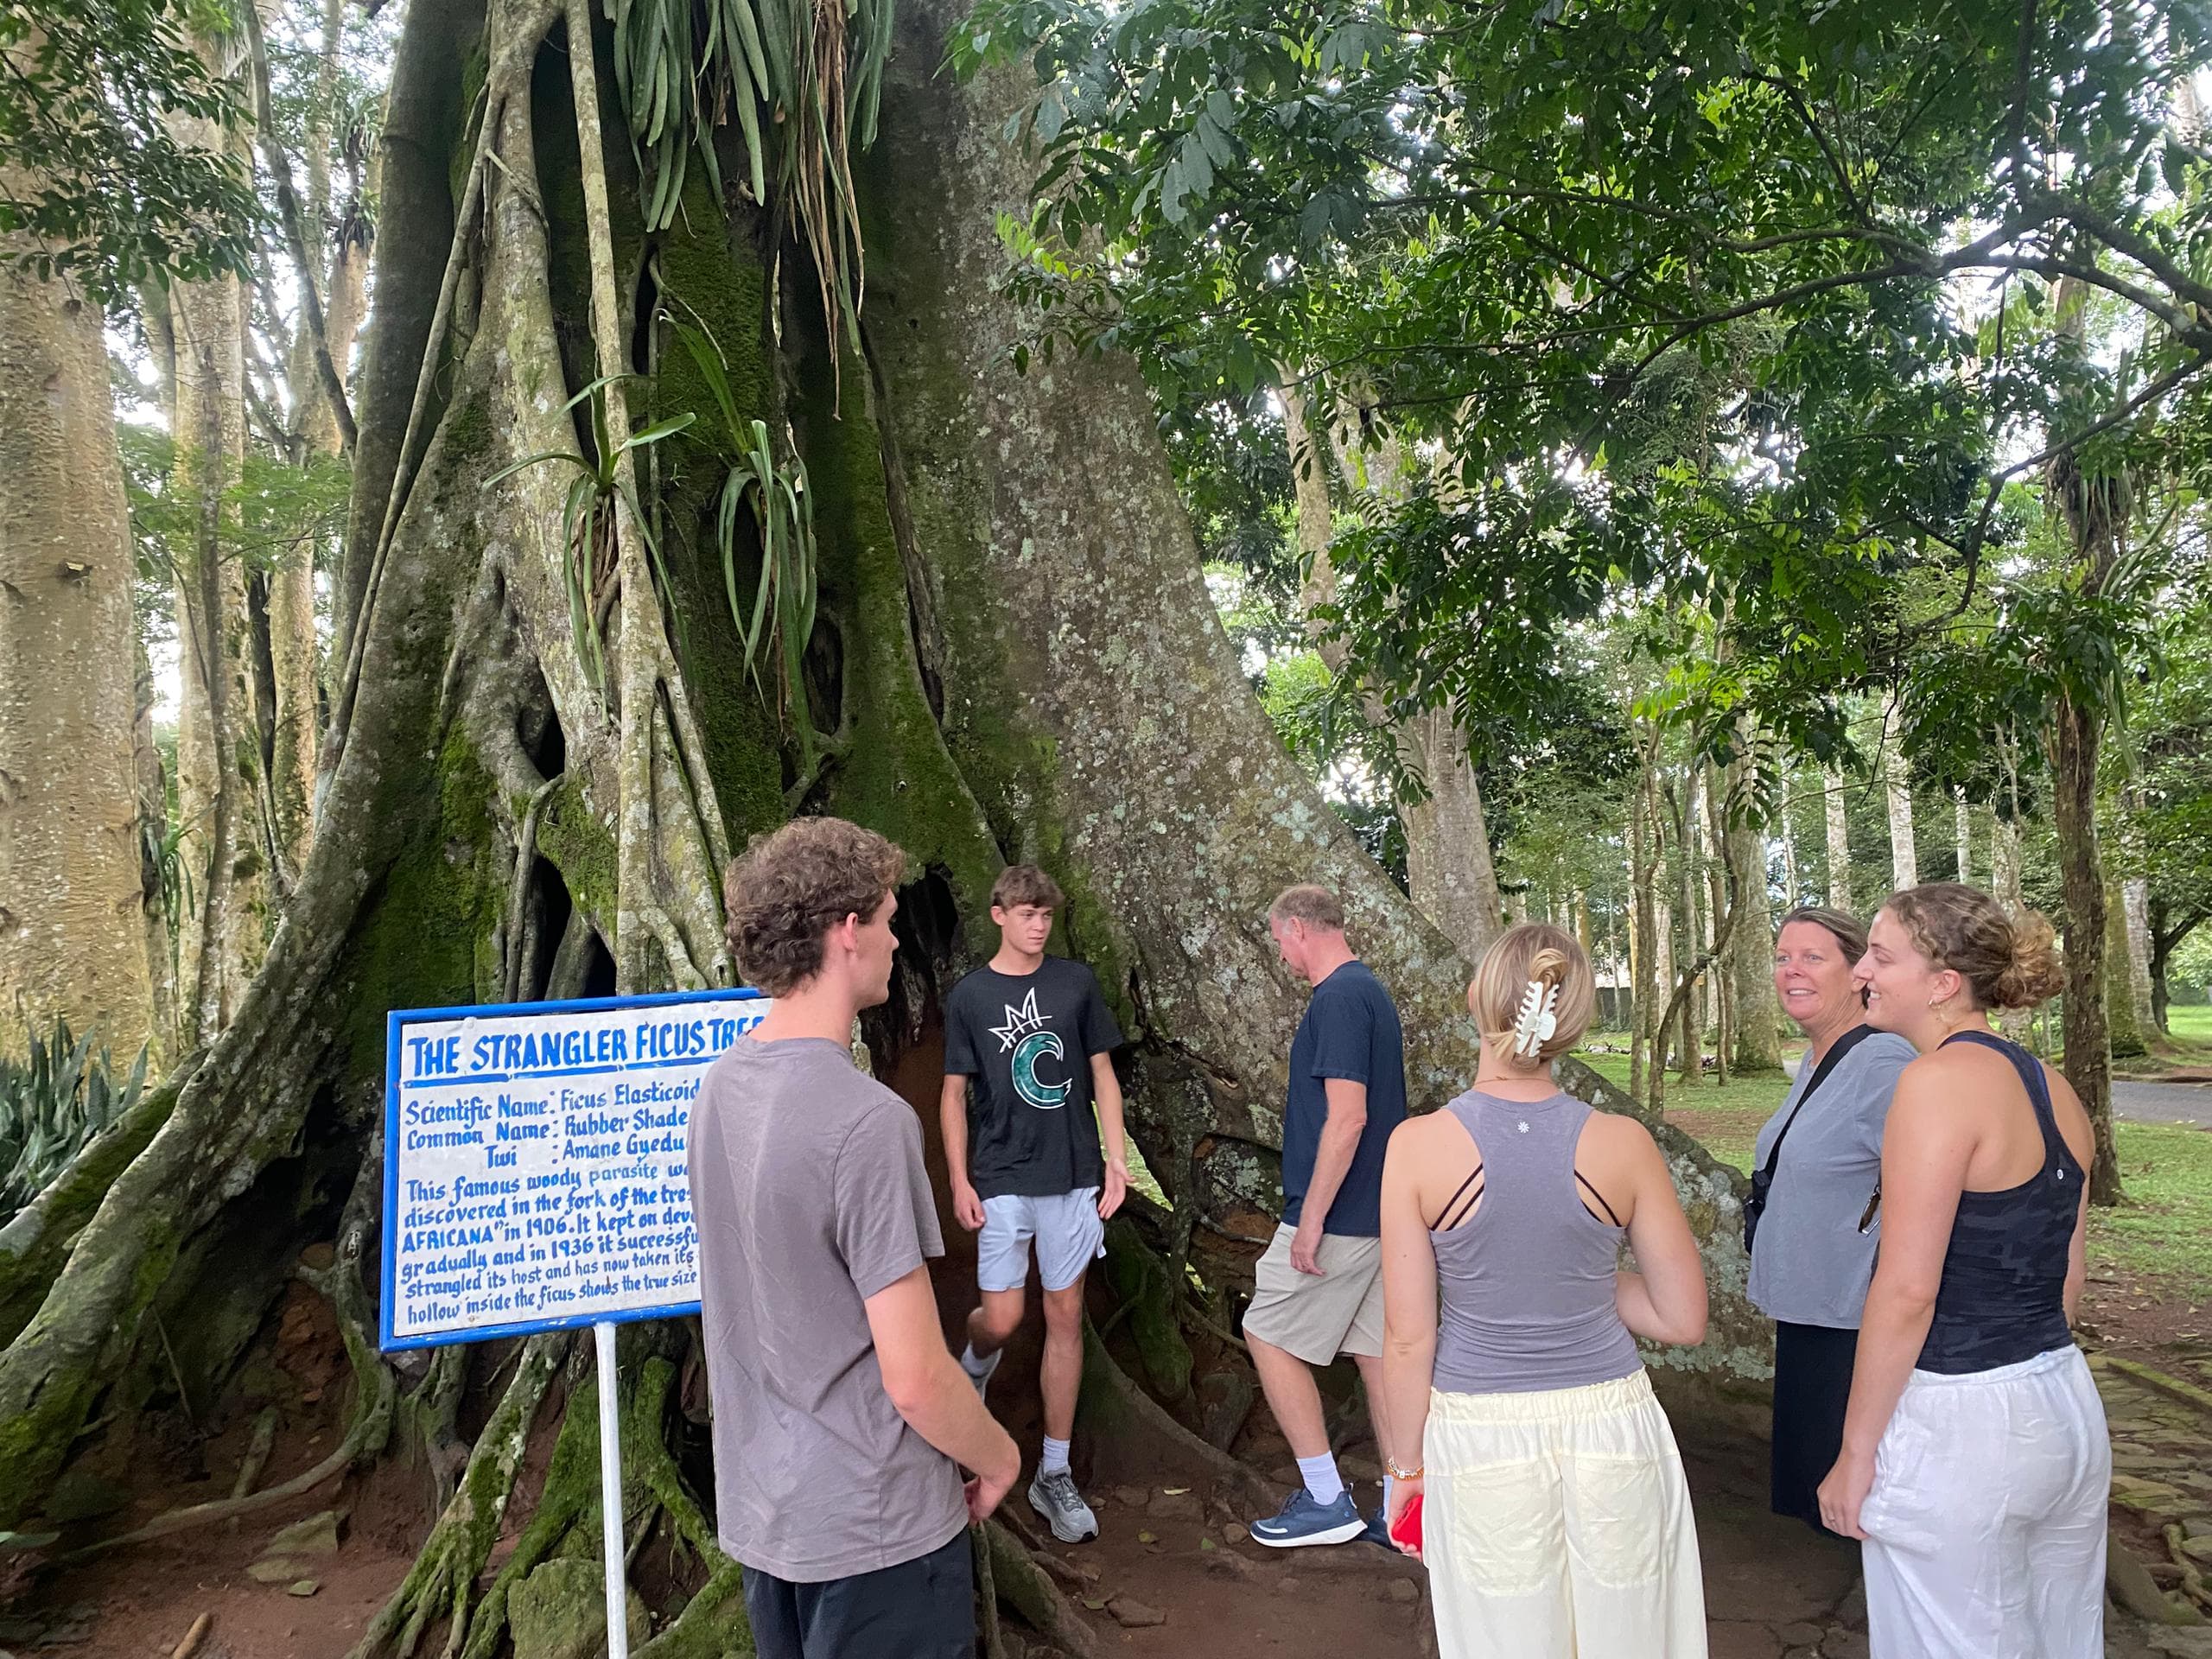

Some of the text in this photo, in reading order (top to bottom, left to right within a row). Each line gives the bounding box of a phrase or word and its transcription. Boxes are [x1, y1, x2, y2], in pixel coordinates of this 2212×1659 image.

[407, 1015, 766, 1077] THE STRANGLER FICUS TRE
[405, 1096, 493, 1129] Scientific
[562, 1089, 607, 1112] Ficus
[408, 1129, 484, 1151] Common
[565, 1111, 629, 1137] Rubber
[632, 1105, 688, 1131] Shade
[484, 1145, 518, 1169] Twi
[563, 1139, 621, 1160] Amane
[626, 1130, 685, 1163] Gyedu
[404, 1198, 507, 1228] discovered
[512, 1196, 530, 1215] in
[535, 1193, 562, 1212] the
[564, 1189, 607, 1215] fork
[610, 1186, 629, 1211] of
[632, 1187, 658, 1205] the
[406, 1179, 446, 1203] This
[448, 1176, 520, 1207] famous
[527, 1167, 582, 1192] woody
[588, 1163, 658, 1187] parasite
[505, 1222, 521, 1242] in
[596, 1210, 636, 1236] kept
[639, 1211, 658, 1228] on
[401, 1249, 487, 1285] gradually
[493, 1243, 525, 1266] and
[529, 1243, 546, 1262] in
[551, 1236, 594, 1259] 1936
[597, 1234, 613, 1254] it
[405, 1249, 694, 1299] strangled its host and has now taken its
[408, 1270, 697, 1325] hollow inside the ficus shows the true size
